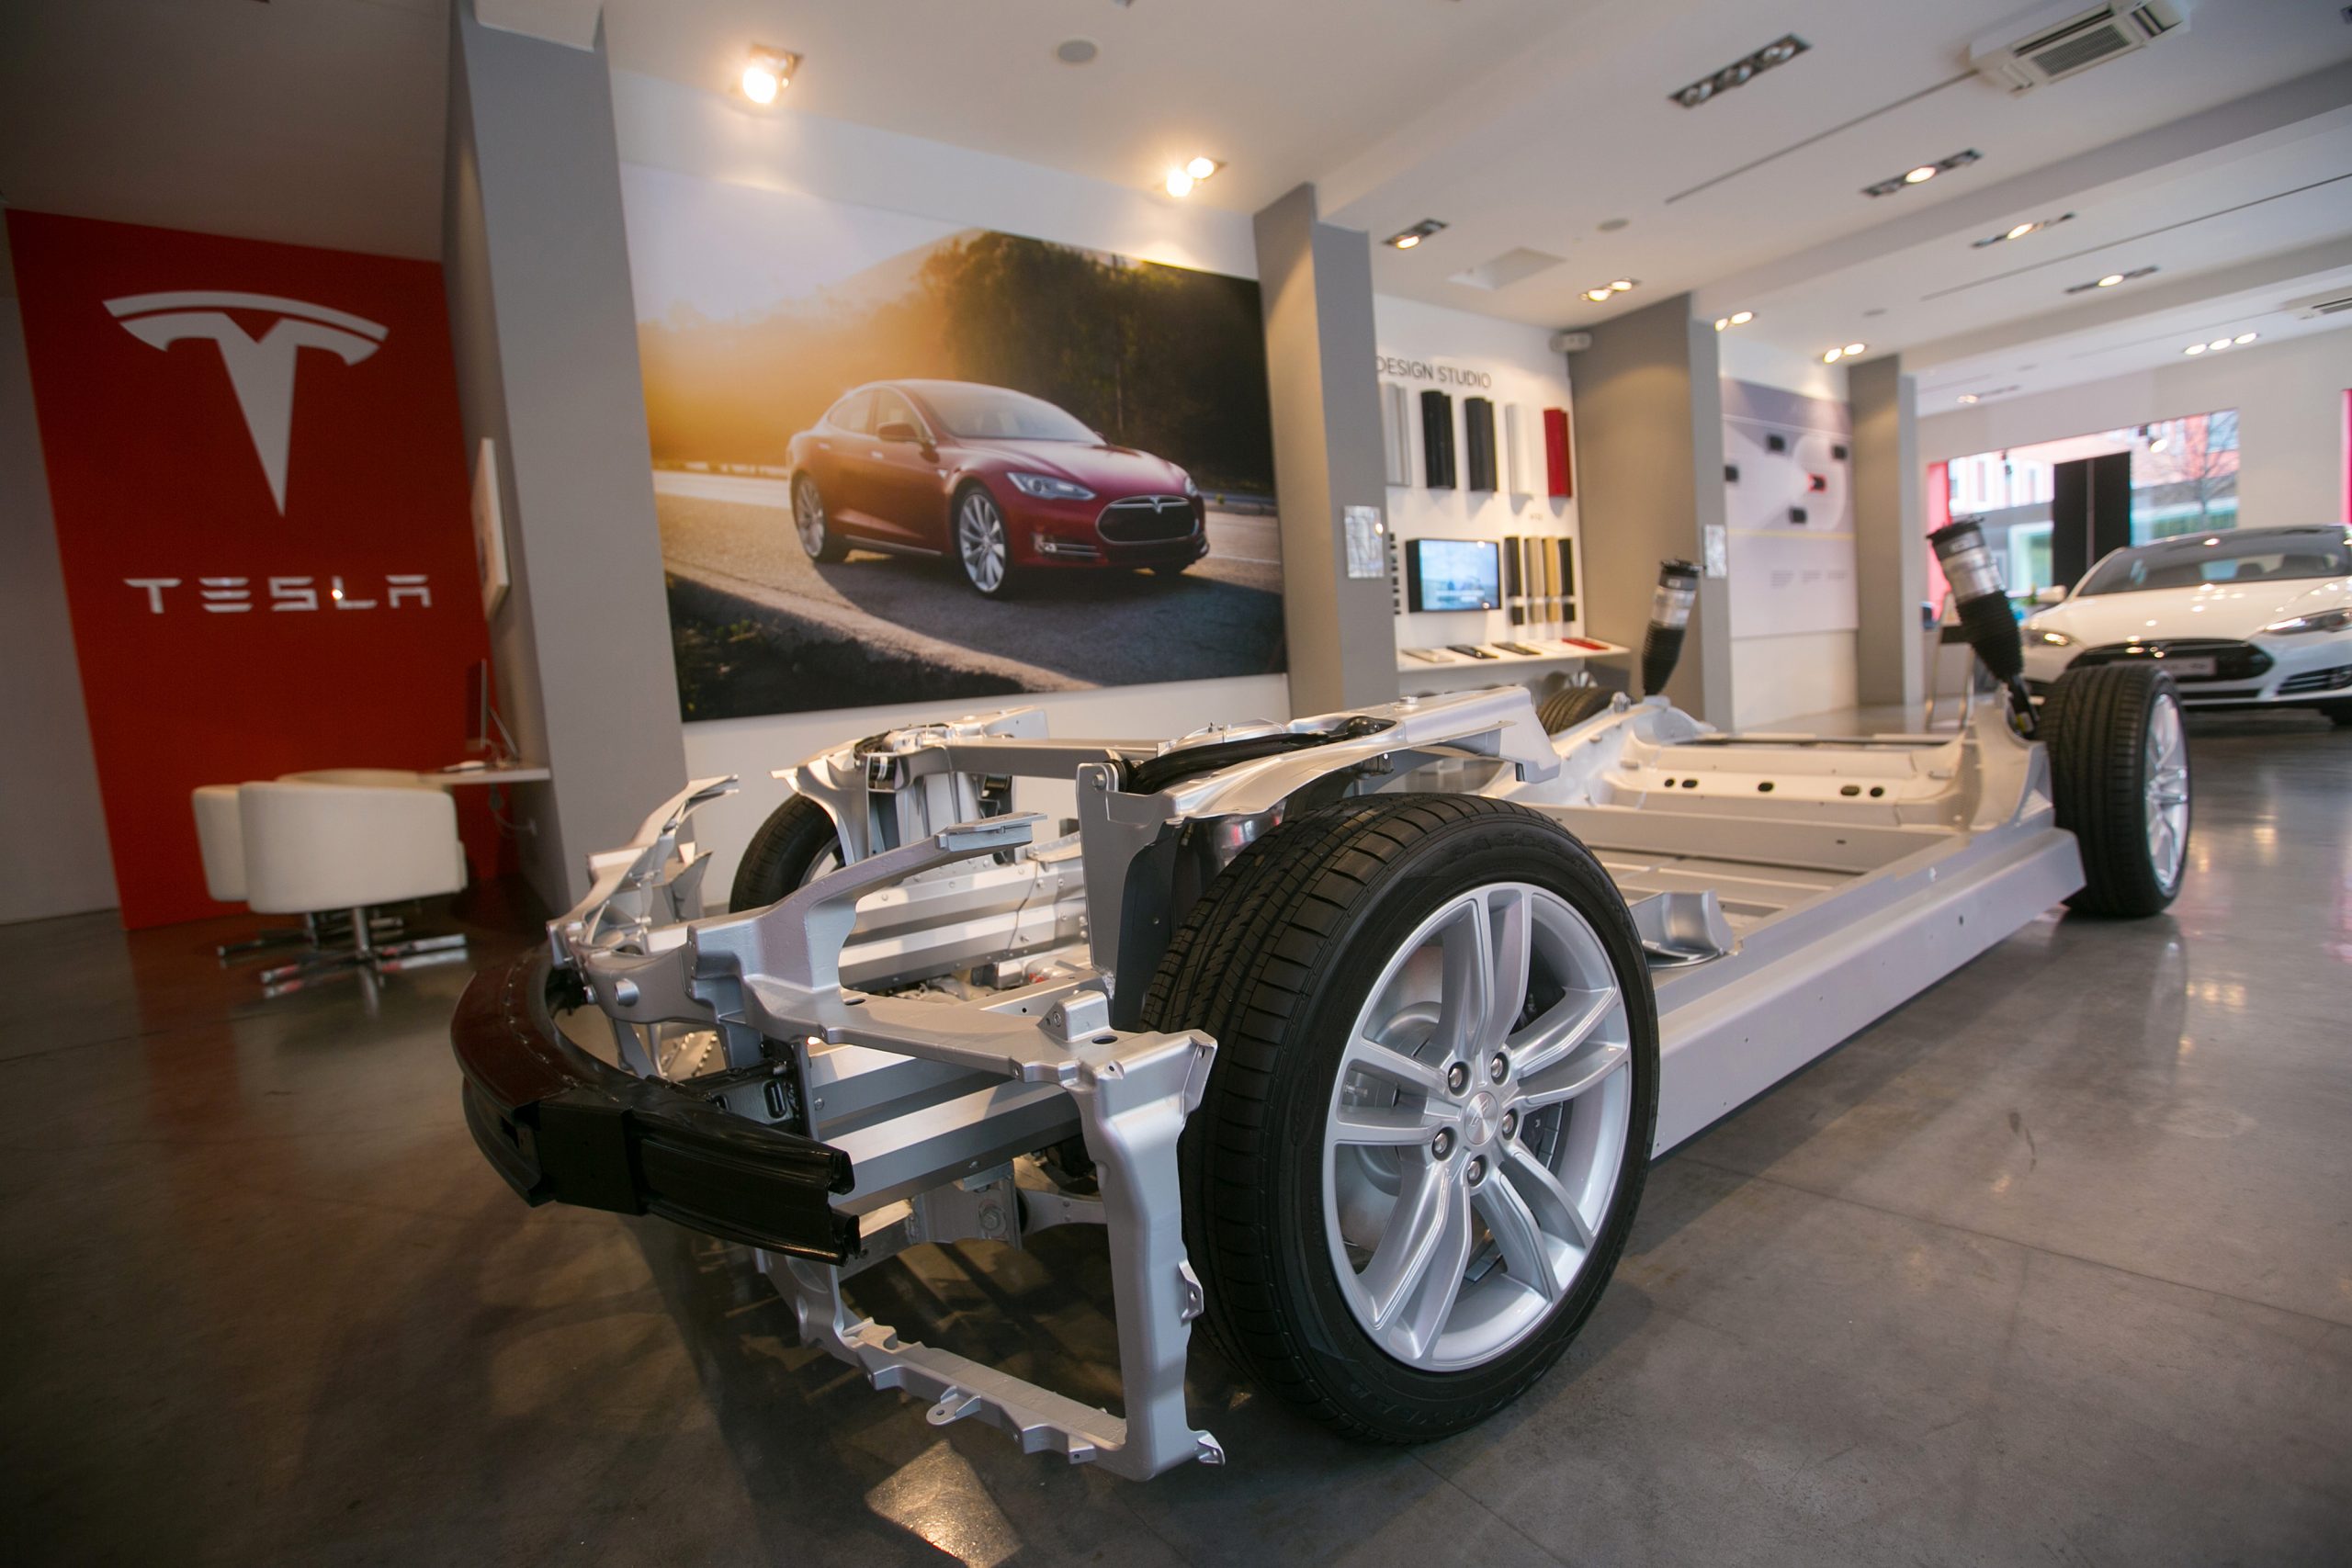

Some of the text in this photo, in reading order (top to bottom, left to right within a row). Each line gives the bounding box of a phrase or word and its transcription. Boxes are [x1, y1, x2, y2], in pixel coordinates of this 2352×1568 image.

[1376, 355, 1492, 389] DESIGN STUDIO
[123, 574, 433, 614] TESLA
